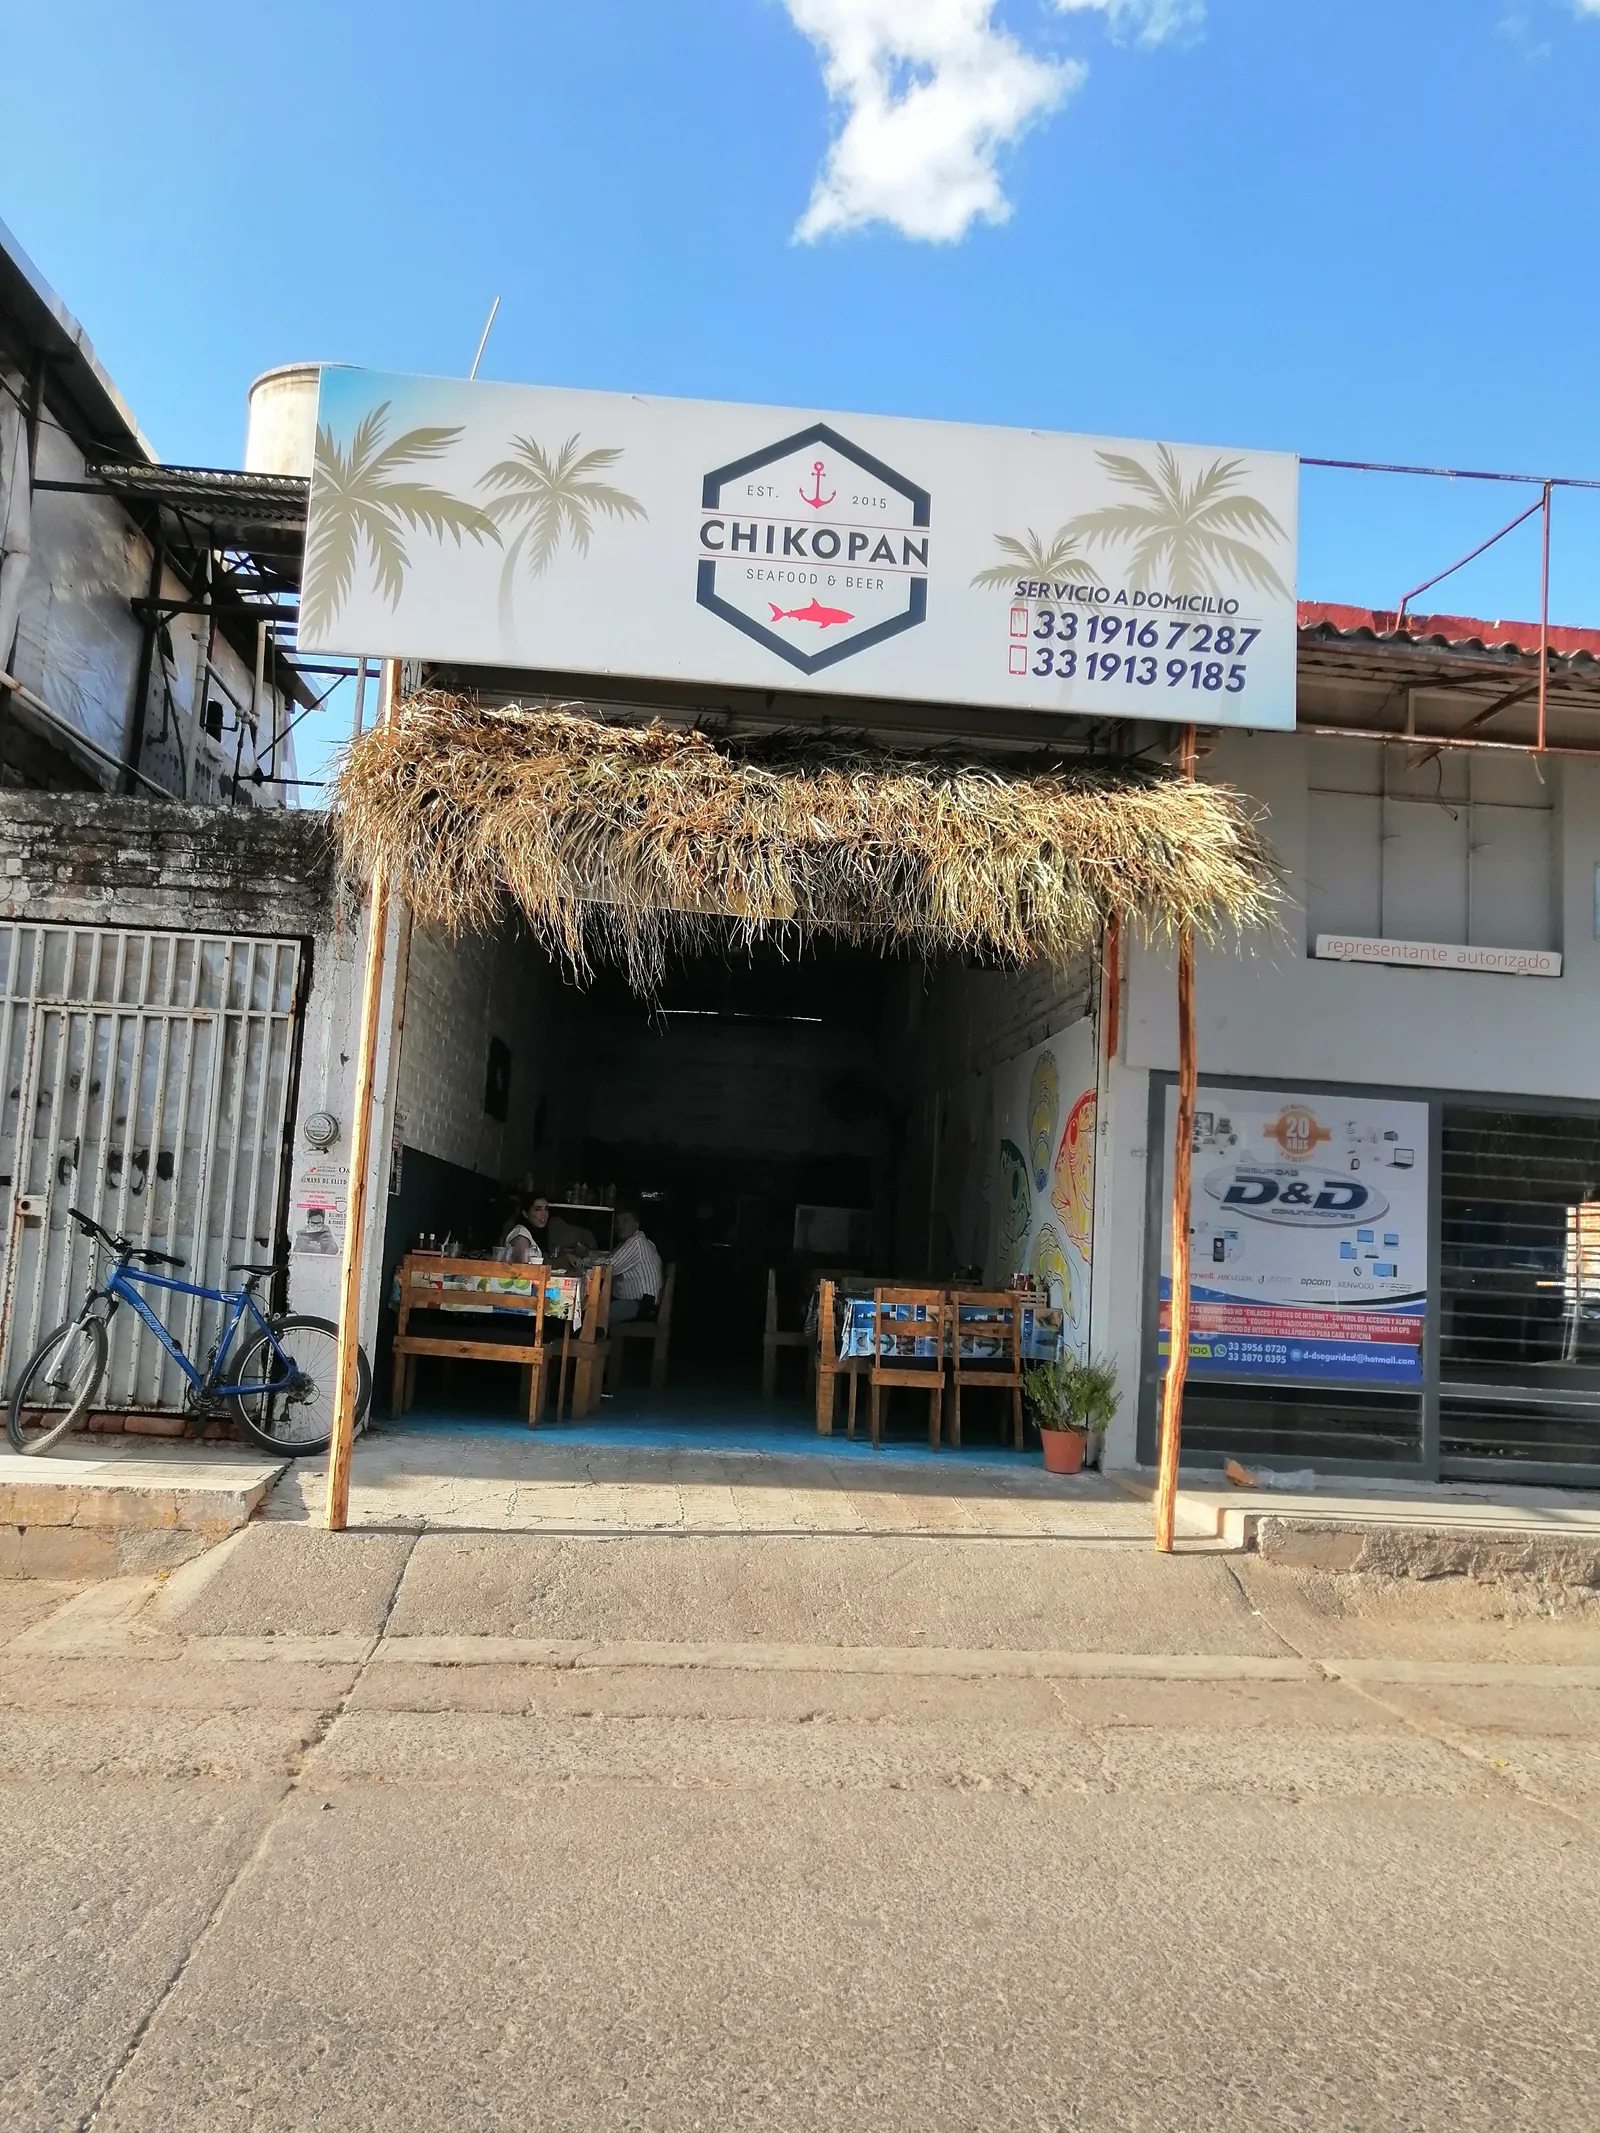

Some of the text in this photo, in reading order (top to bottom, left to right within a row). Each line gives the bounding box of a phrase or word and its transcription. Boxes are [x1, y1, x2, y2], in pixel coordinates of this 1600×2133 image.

[747, 485, 887, 509] EST. 2015
[700, 519, 929, 568] CHIKOPAN
[746, 568, 884, 590] SEAFOOD & BEER
[1014, 580, 1239, 615] SERVICIO A DOMICILIO
[1032, 610, 1262, 656] 33 1916 7287
[1032, 647, 1247, 693] 33 1913 9185
[1327, 939, 1551, 970] representante autorizado
[1287, 1116, 1309, 1138] 20
[1235, 1166, 1299, 1177] SEGURIDAD
[1223, 1175, 1369, 1210] D&D
[1300, 1277, 1331, 1286] epcom
[1338, 1281, 1374, 1290] KENWOOD
[1303, 1312, 1329, 1320] INTERNET
[1228, 1342, 1287, 1353] 33 3956 0720
[1228, 1352, 1287, 1364] 33 3870 0395
